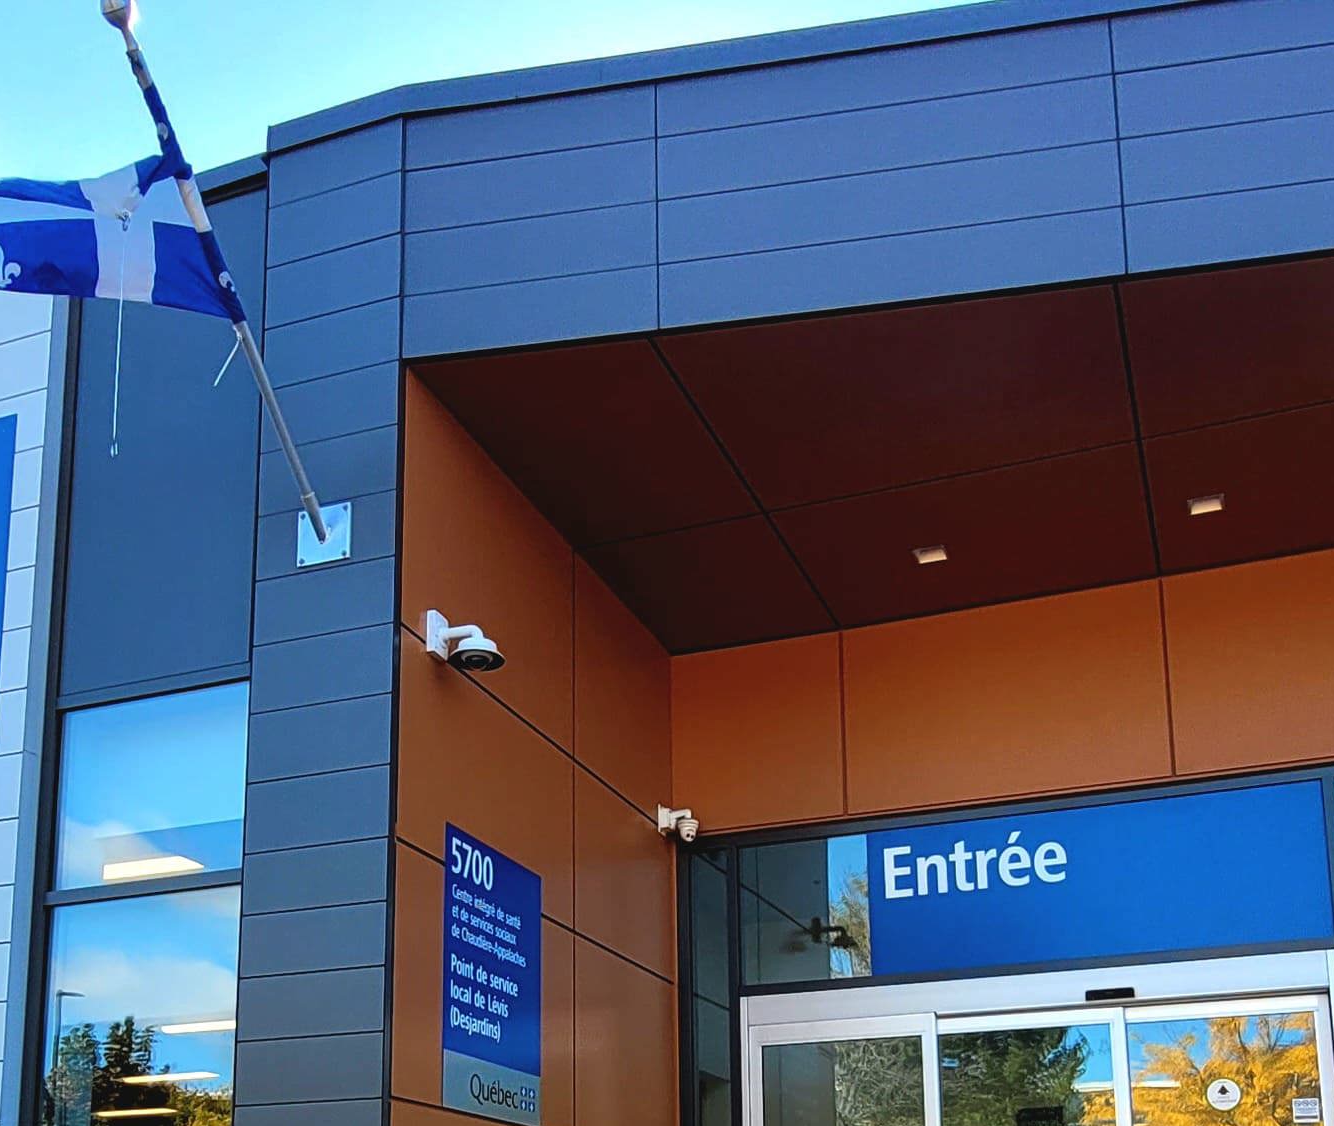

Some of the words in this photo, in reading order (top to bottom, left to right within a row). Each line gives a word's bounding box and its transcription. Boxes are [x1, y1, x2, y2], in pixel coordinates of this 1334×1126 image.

[451, 836, 494, 891] 5700
[883, 830, 1067, 899] Entrée
[450, 953, 474, 980] Point
[476, 965, 488, 985] de
[489, 974, 519, 997] service
[450, 979, 472, 1005] local
[474, 990, 486, 1010] de
[487, 993, 509, 1018] Lévis
[450, 1004, 501, 1043] (Desjardins)
[470, 1073, 519, 1109] Québec
